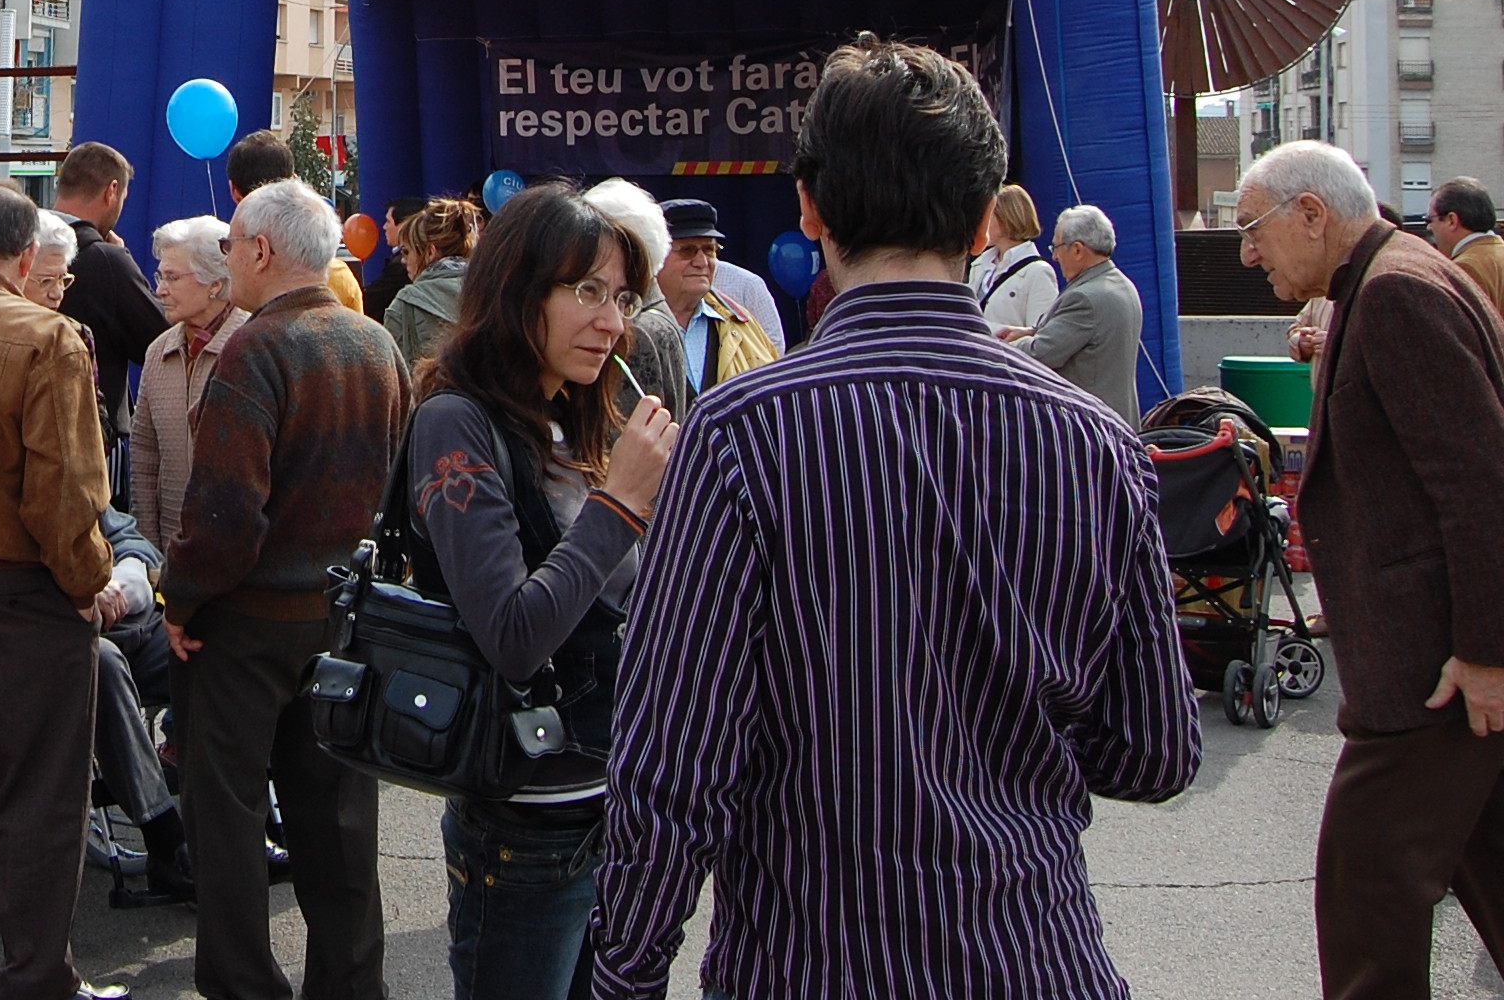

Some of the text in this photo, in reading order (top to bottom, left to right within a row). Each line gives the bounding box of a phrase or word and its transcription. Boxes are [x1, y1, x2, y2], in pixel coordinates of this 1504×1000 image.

[498, 52, 818, 95] El teu vot farà
[499, 102, 710, 146] respectar
